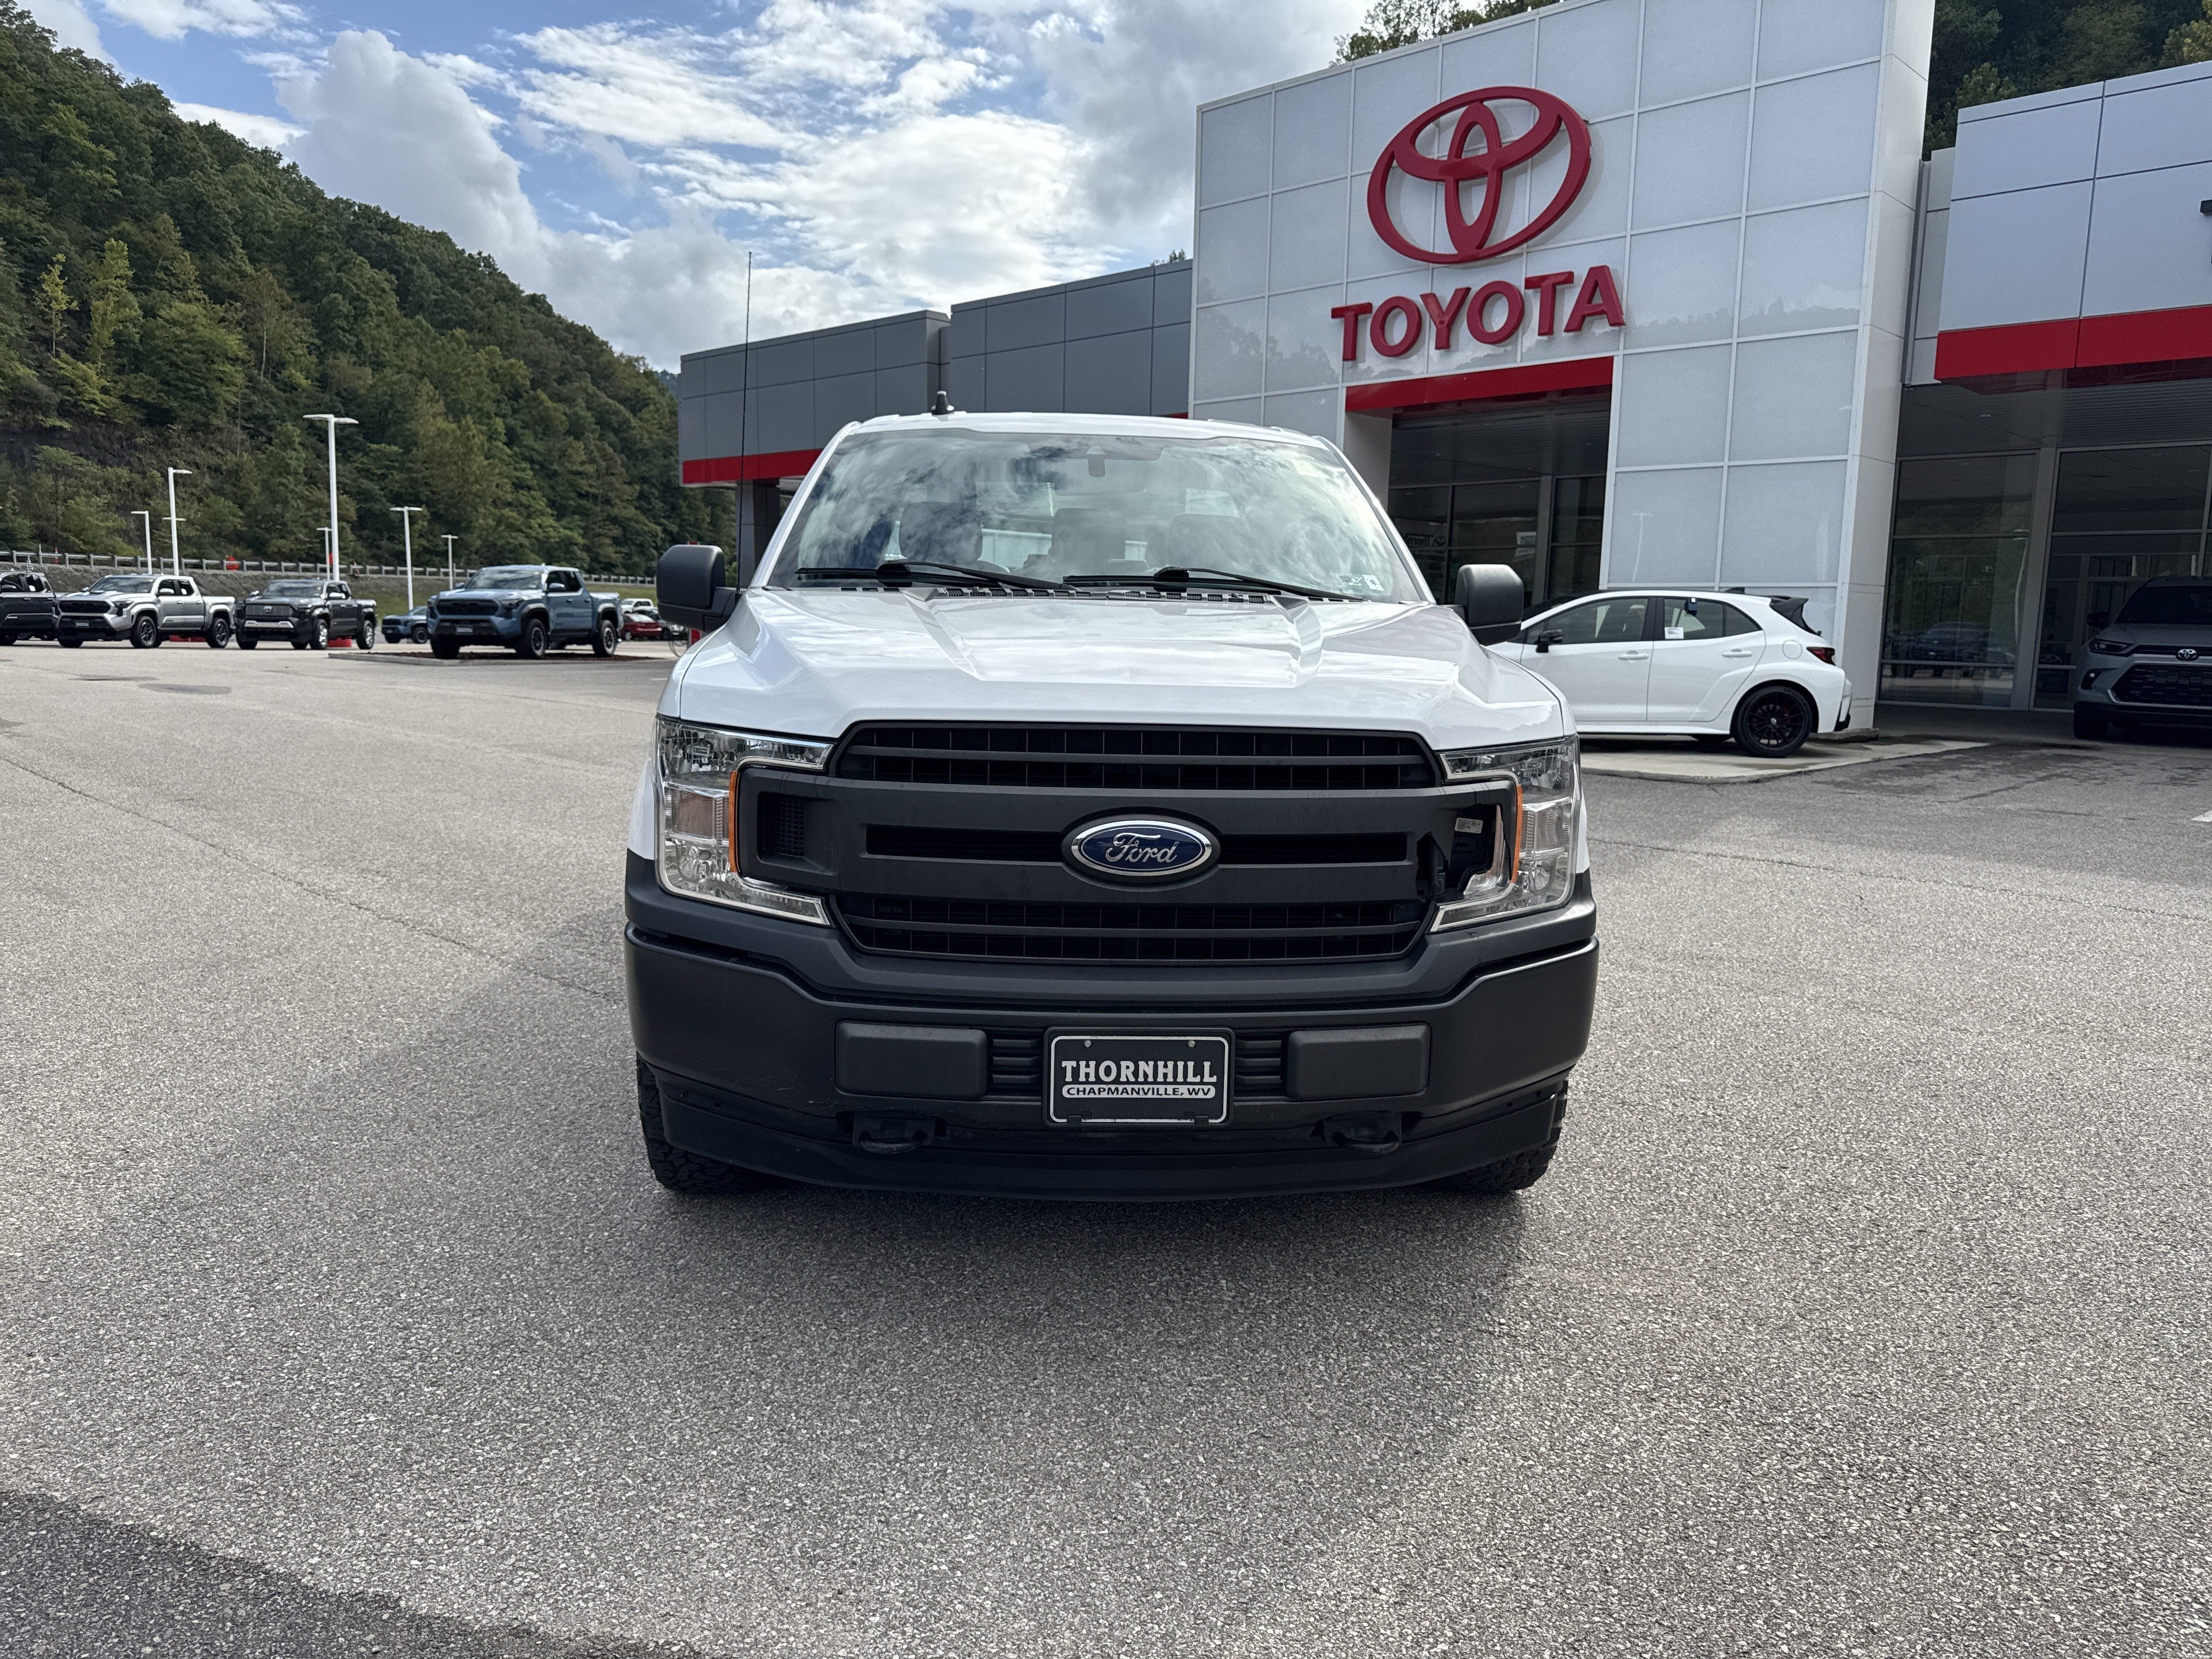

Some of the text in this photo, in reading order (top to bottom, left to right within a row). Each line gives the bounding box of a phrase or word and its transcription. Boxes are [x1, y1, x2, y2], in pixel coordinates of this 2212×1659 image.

[1331, 265, 1625, 361] TOYOTA
[1105, 832, 1180, 862] Ford
[1062, 1060, 1217, 1082] THORNHILL
[1066, 1087, 1211, 1096] CHAPMANVILLE, WV
